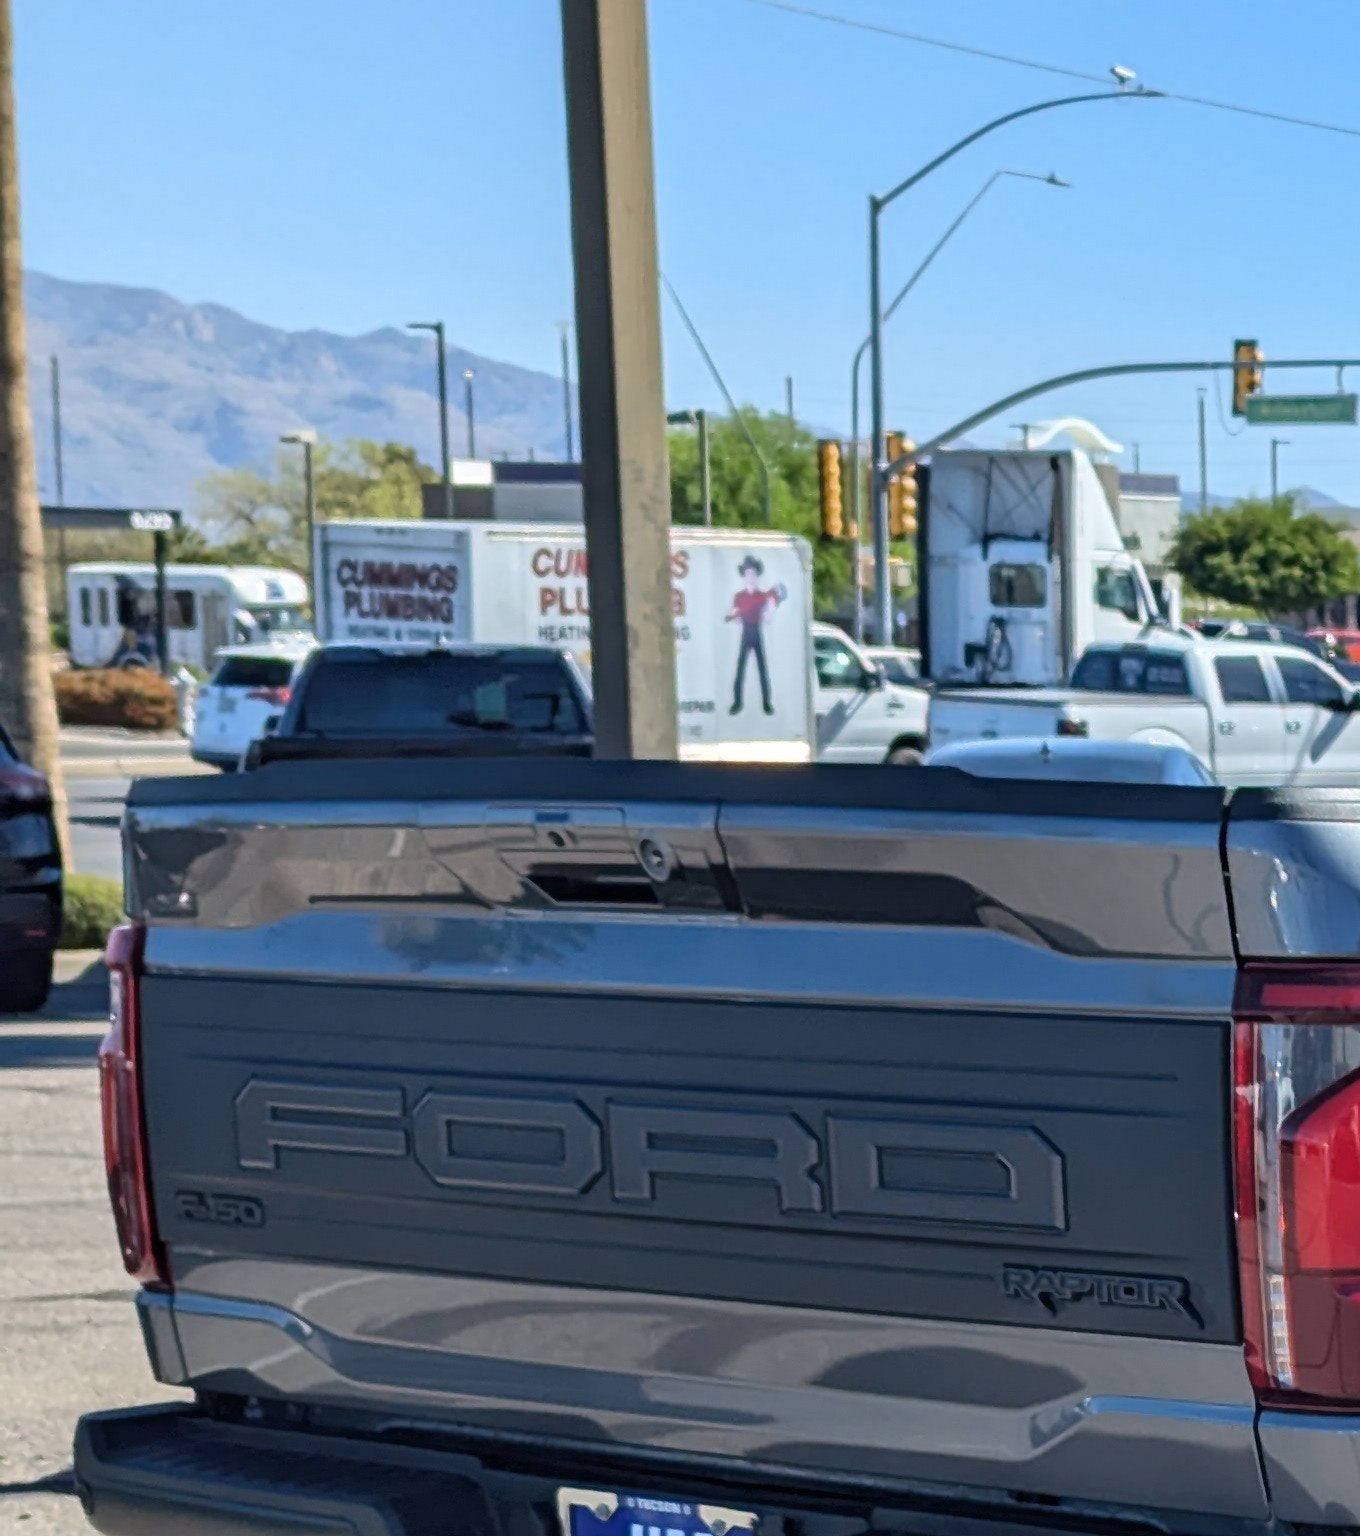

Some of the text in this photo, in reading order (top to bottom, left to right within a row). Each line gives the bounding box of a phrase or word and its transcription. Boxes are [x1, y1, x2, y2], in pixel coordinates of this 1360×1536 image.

[337, 559, 458, 593] CUMMINGS
[344, 590, 454, 624] PLUMBING
[234, 1074, 1071, 1232] FORD
[1002, 1263, 1205, 1329] RAPTOR
